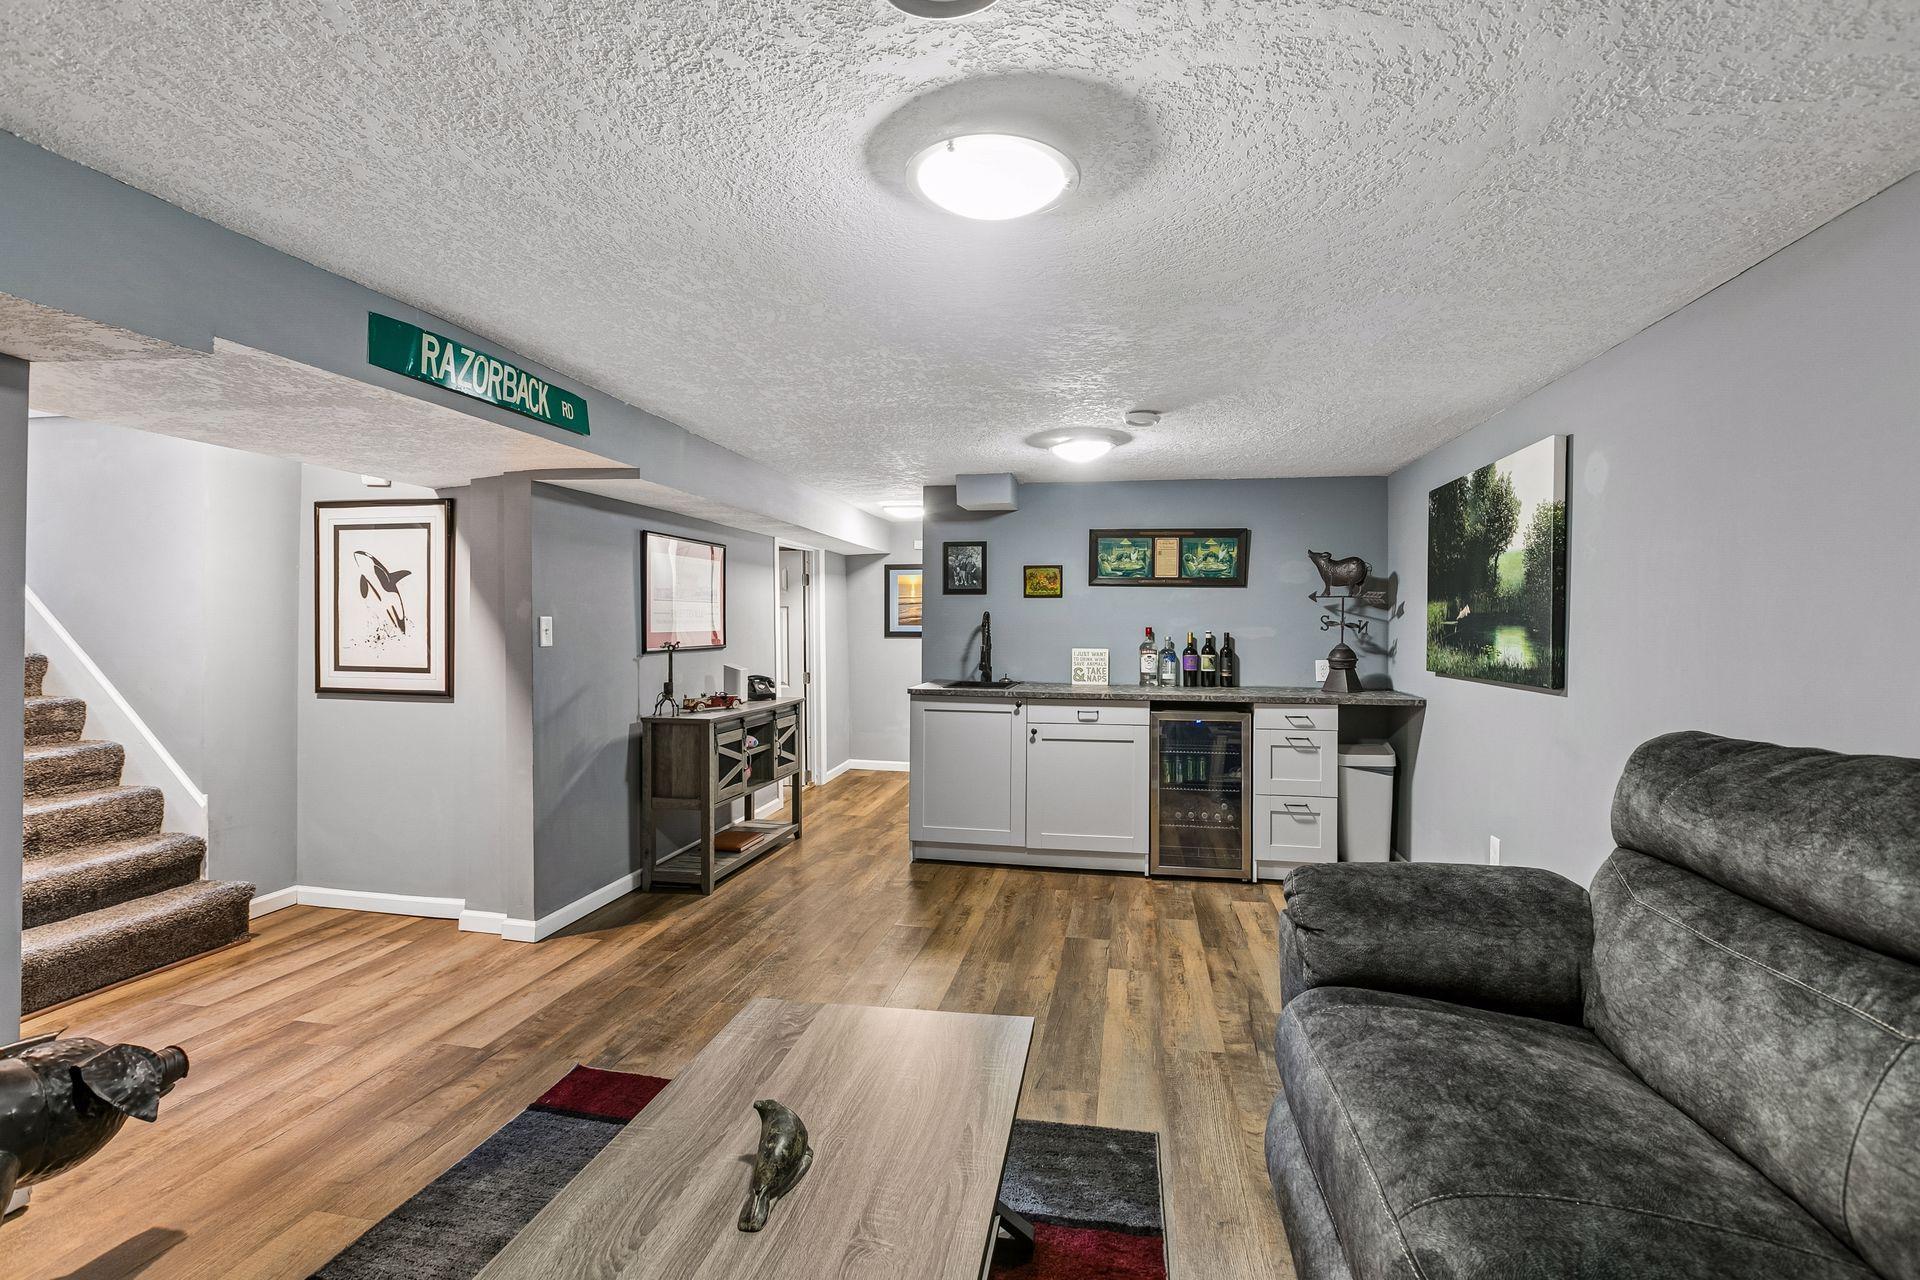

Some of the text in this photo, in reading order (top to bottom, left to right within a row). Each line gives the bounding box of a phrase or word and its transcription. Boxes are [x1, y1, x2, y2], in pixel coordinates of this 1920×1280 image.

[421, 332, 574, 420] RAZORBACK RD
[1320, 615, 1330, 632] S
[1073, 667, 1107, 682] & TAKE
